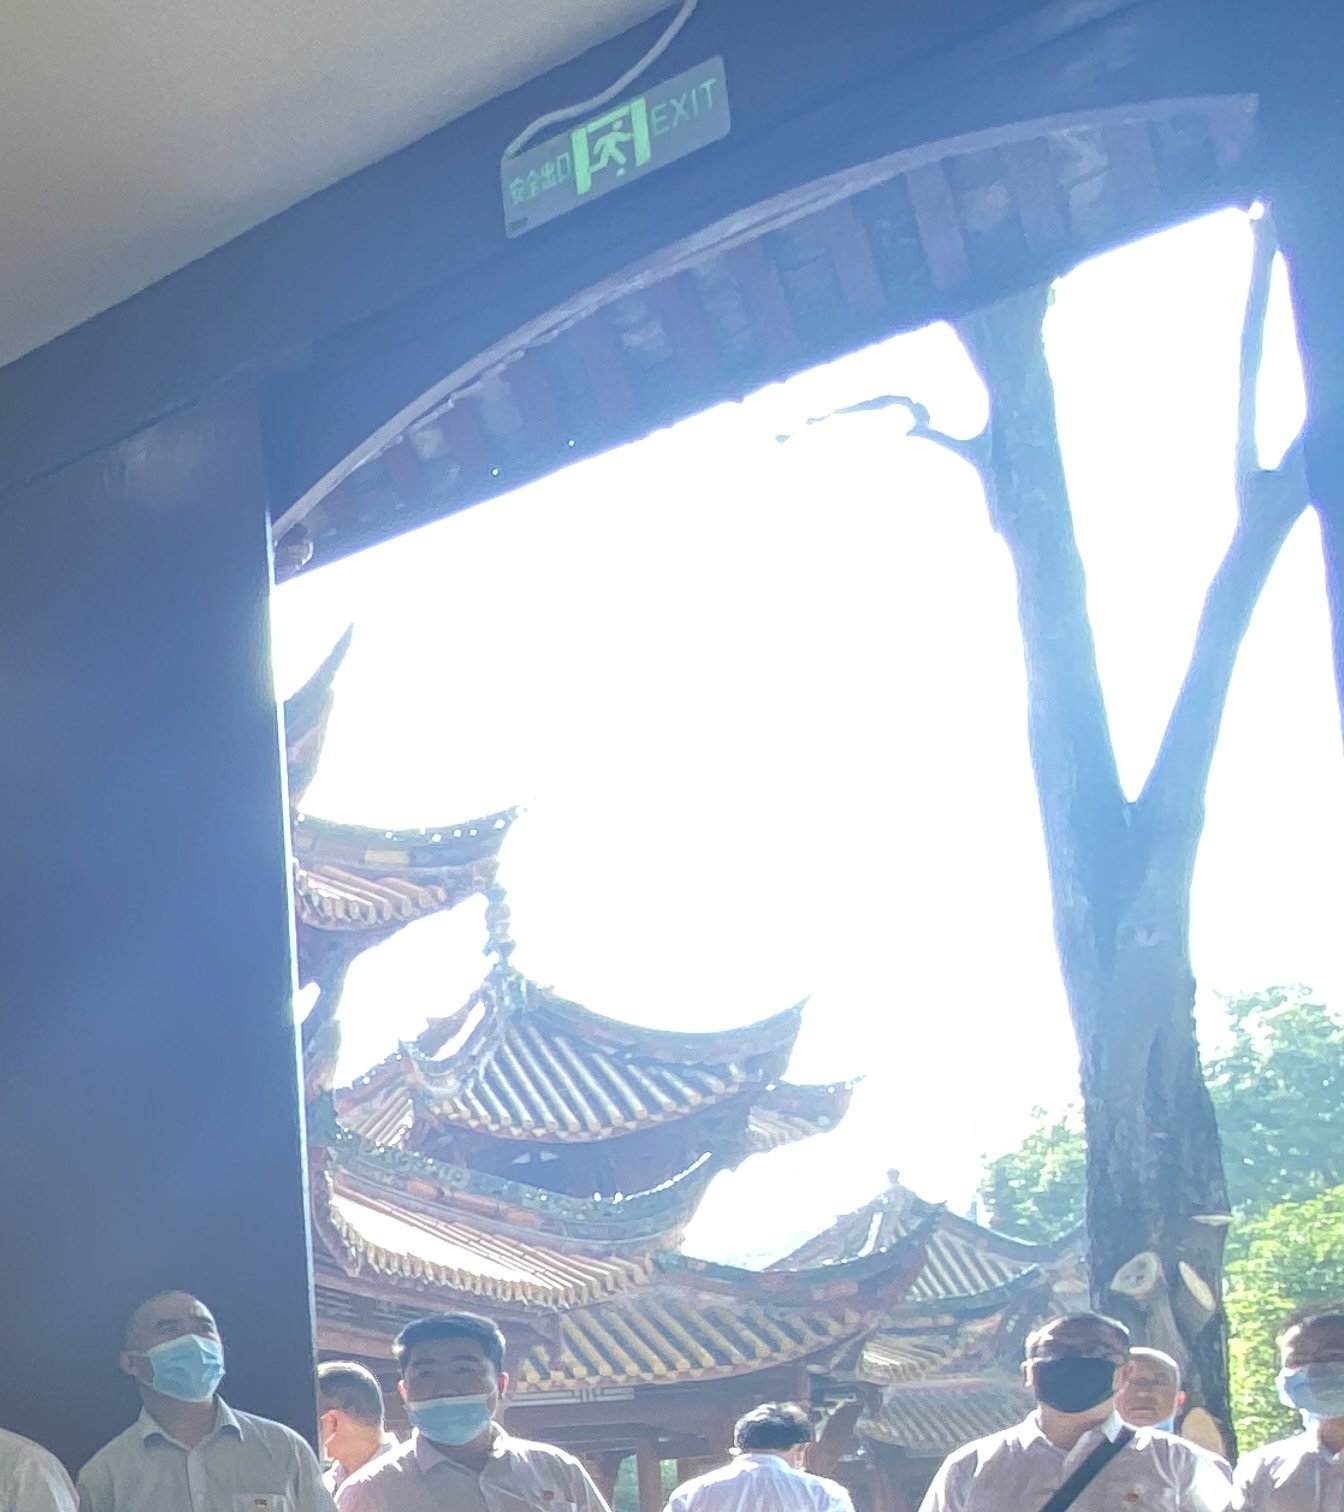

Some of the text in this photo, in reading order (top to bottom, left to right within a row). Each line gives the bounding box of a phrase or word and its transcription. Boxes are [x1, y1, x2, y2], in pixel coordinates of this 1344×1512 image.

[650, 79, 716, 137] EXIT
[508, 152, 571, 204] 安全出口
